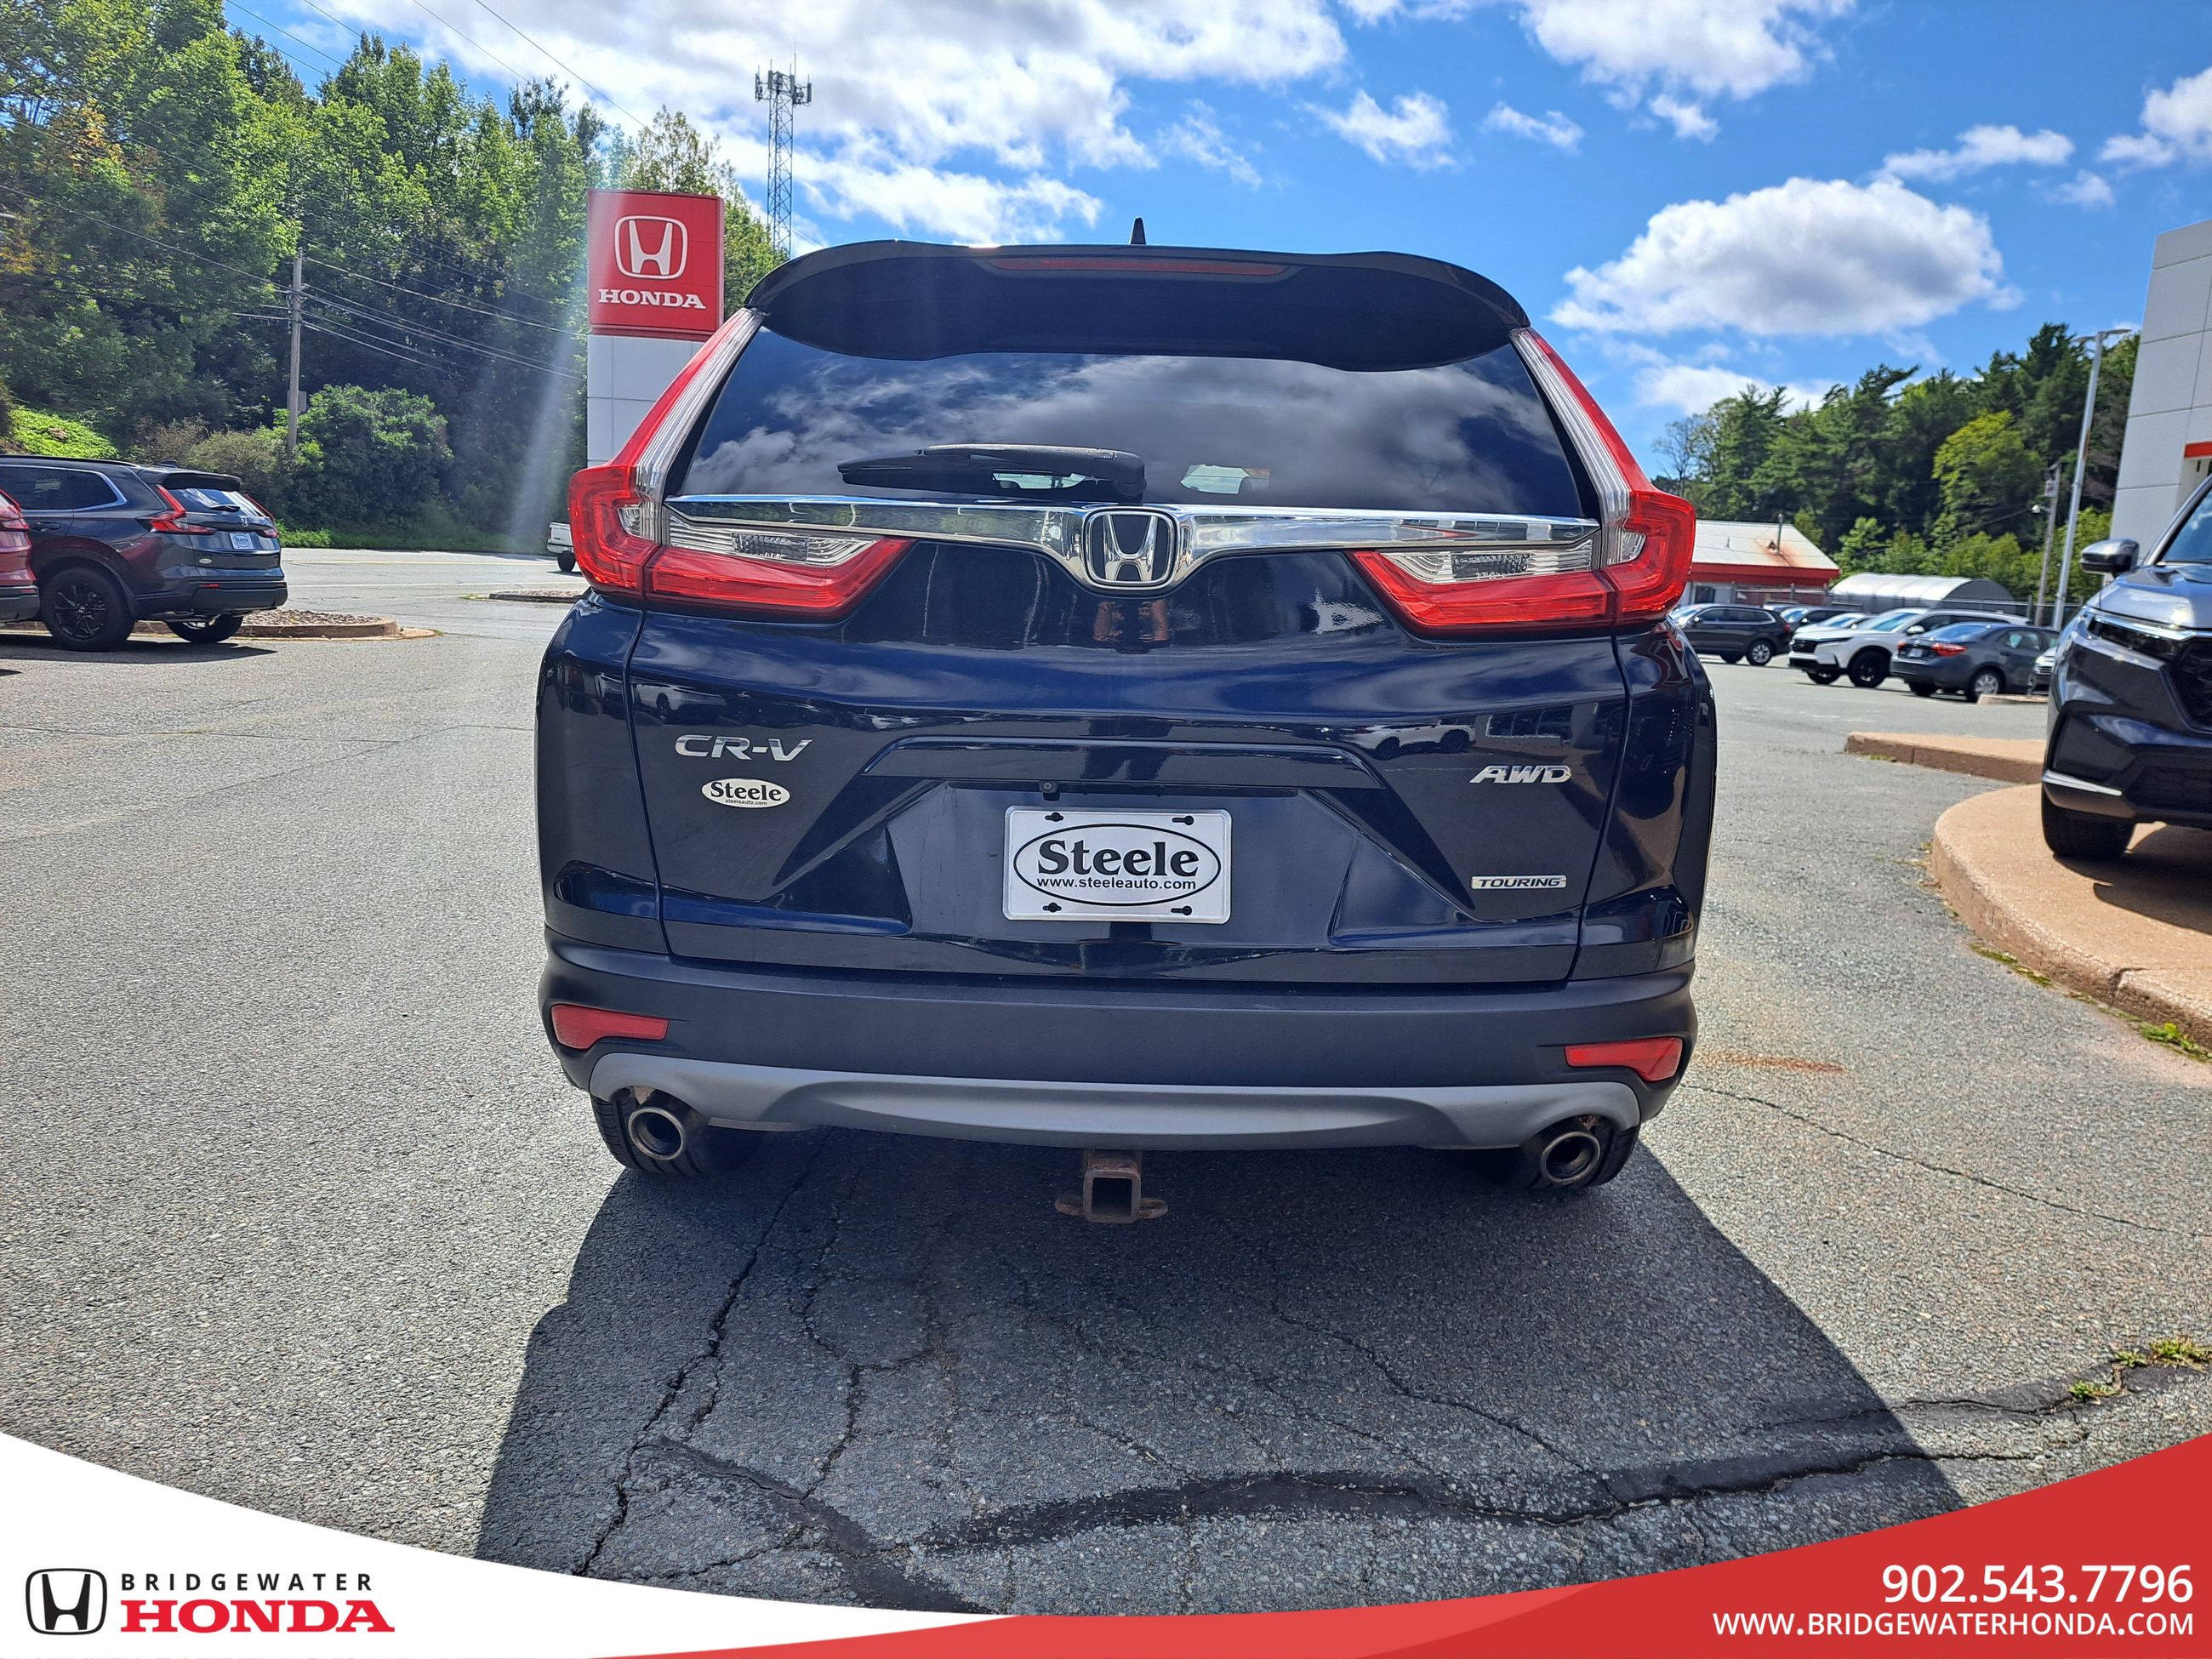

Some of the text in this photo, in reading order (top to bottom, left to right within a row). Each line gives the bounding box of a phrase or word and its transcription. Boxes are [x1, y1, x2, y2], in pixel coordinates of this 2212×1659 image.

[598, 289, 706, 309] HONDA
[676, 734, 813, 761] CR-V
[1469, 766, 1572, 784] AWD
[710, 782, 782, 801] Steele
[1038, 840, 1199, 877] Steele
[1037, 877, 1196, 890] www.steeleauto.com
[1479, 877, 1561, 887] TOURING
